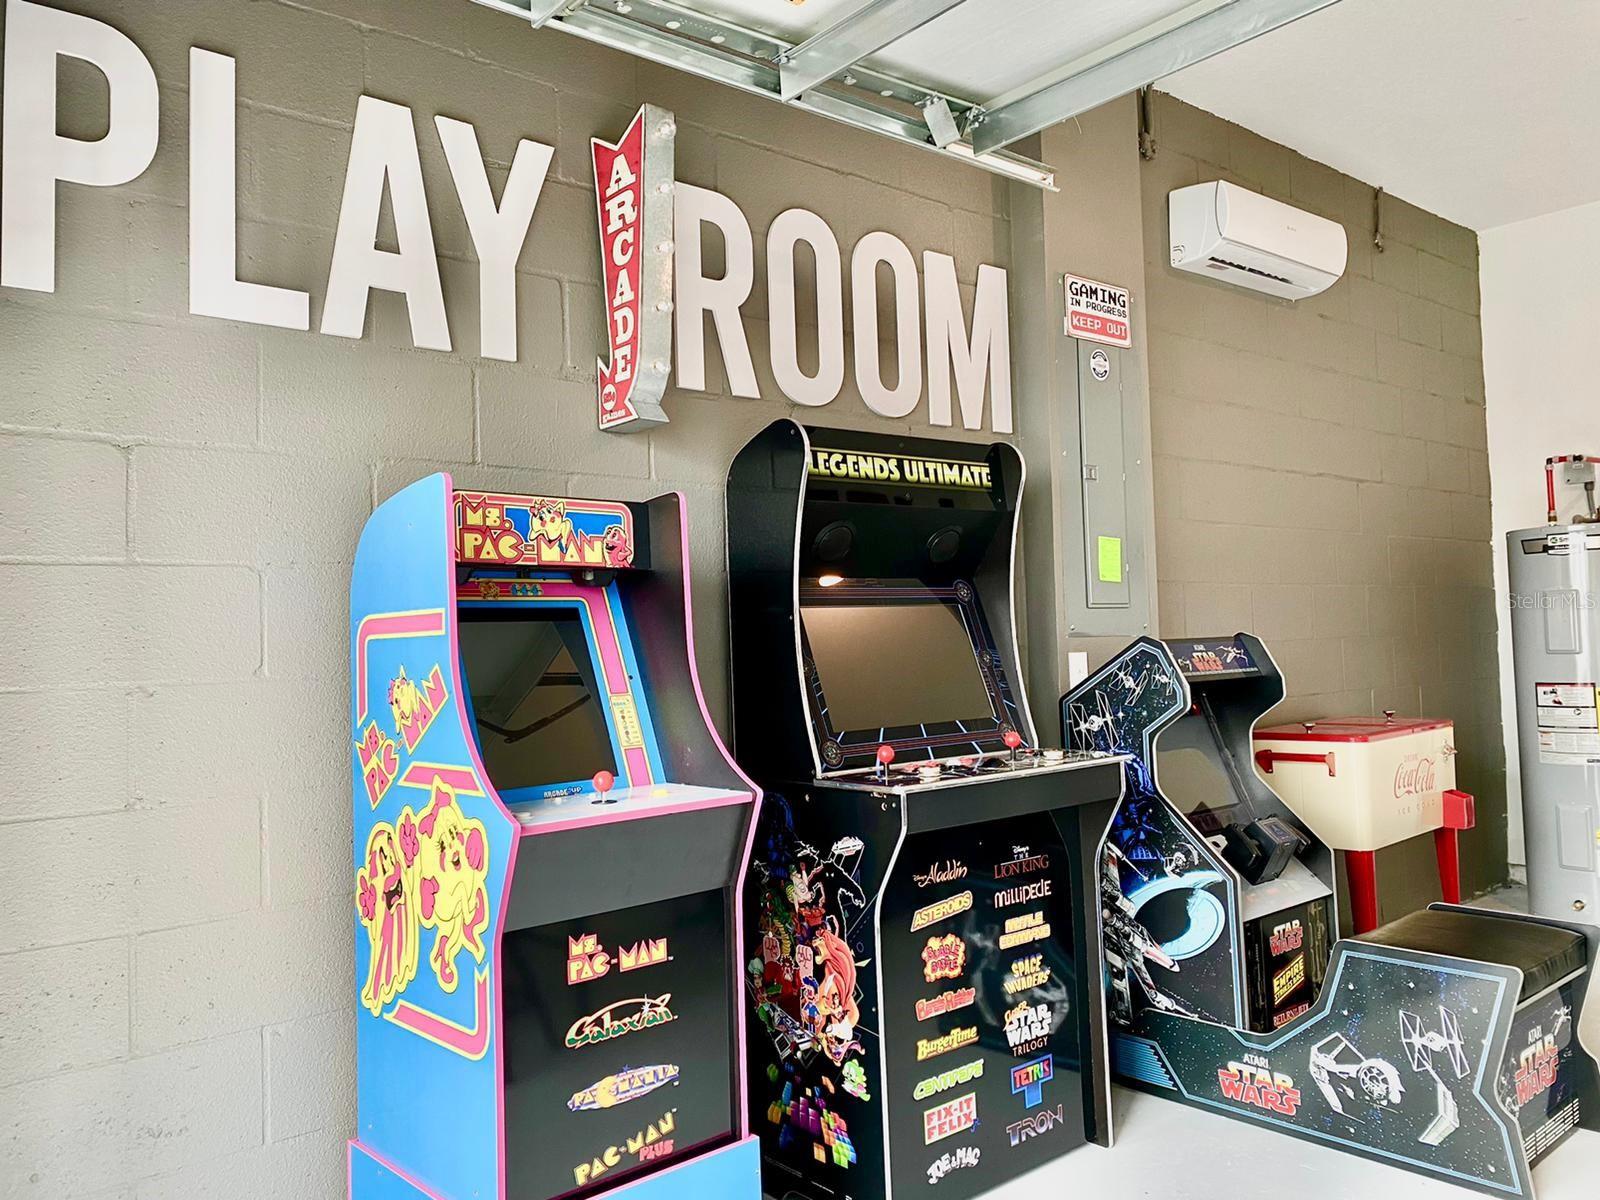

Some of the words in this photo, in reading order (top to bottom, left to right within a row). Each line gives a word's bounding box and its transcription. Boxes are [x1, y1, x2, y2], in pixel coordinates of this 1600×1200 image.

[0, 0, 555, 362] PLAY
[674, 181, 1013, 434] ROOM
[605, 153, 638, 384] ARCADE
[1069, 281, 1126, 308] GAMING
[1070, 297, 1081, 307] IN
[1086, 301, 1127, 318] PROGRESS
[1072, 315, 1101, 330] KEEP
[1107, 323, 1126, 337] OUT
[808, 451, 900, 482] LEGENDS
[903, 460, 992, 488] ULTIMATE
[918, 859, 968, 888] Aladdin
[994, 864, 1020, 879] LION
[1022, 855, 1050, 873] KING
[914, 893, 972, 928] ASTEROIDS
[1270, 919, 1303, 944] STAR
[1270, 935, 1303, 956] WARS
[1011, 953, 1043, 977] SPACE
[1273, 958, 1304, 993] EMPIRE
[1004, 968, 1051, 995] INVADERS
[1006, 1004, 1052, 1032] STAR
[1006, 1018, 1052, 1048] WARS
[1012, 1036, 1049, 1057] TRILOGY
[1243, 1053, 1269, 1068] ATARI
[1515, 1033, 1559, 1081] STAR
[1013, 1060, 1051, 1088] TETRIS
[1218, 1061, 1300, 1097] STAR
[1515, 1056, 1559, 1107] WARS
[926, 1097, 973, 1126] FIX-IT
[1219, 1079, 1301, 1116] WARS
[927, 1111, 973, 1140] FELIX
[1006, 1104, 1064, 1147] TRON
[574, 1112, 676, 1187] PAC-MAN
[639, 1139, 674, 1162] PLUS
[927, 1153, 951, 1185] JOE
[955, 1147, 981, 1169] MAC
